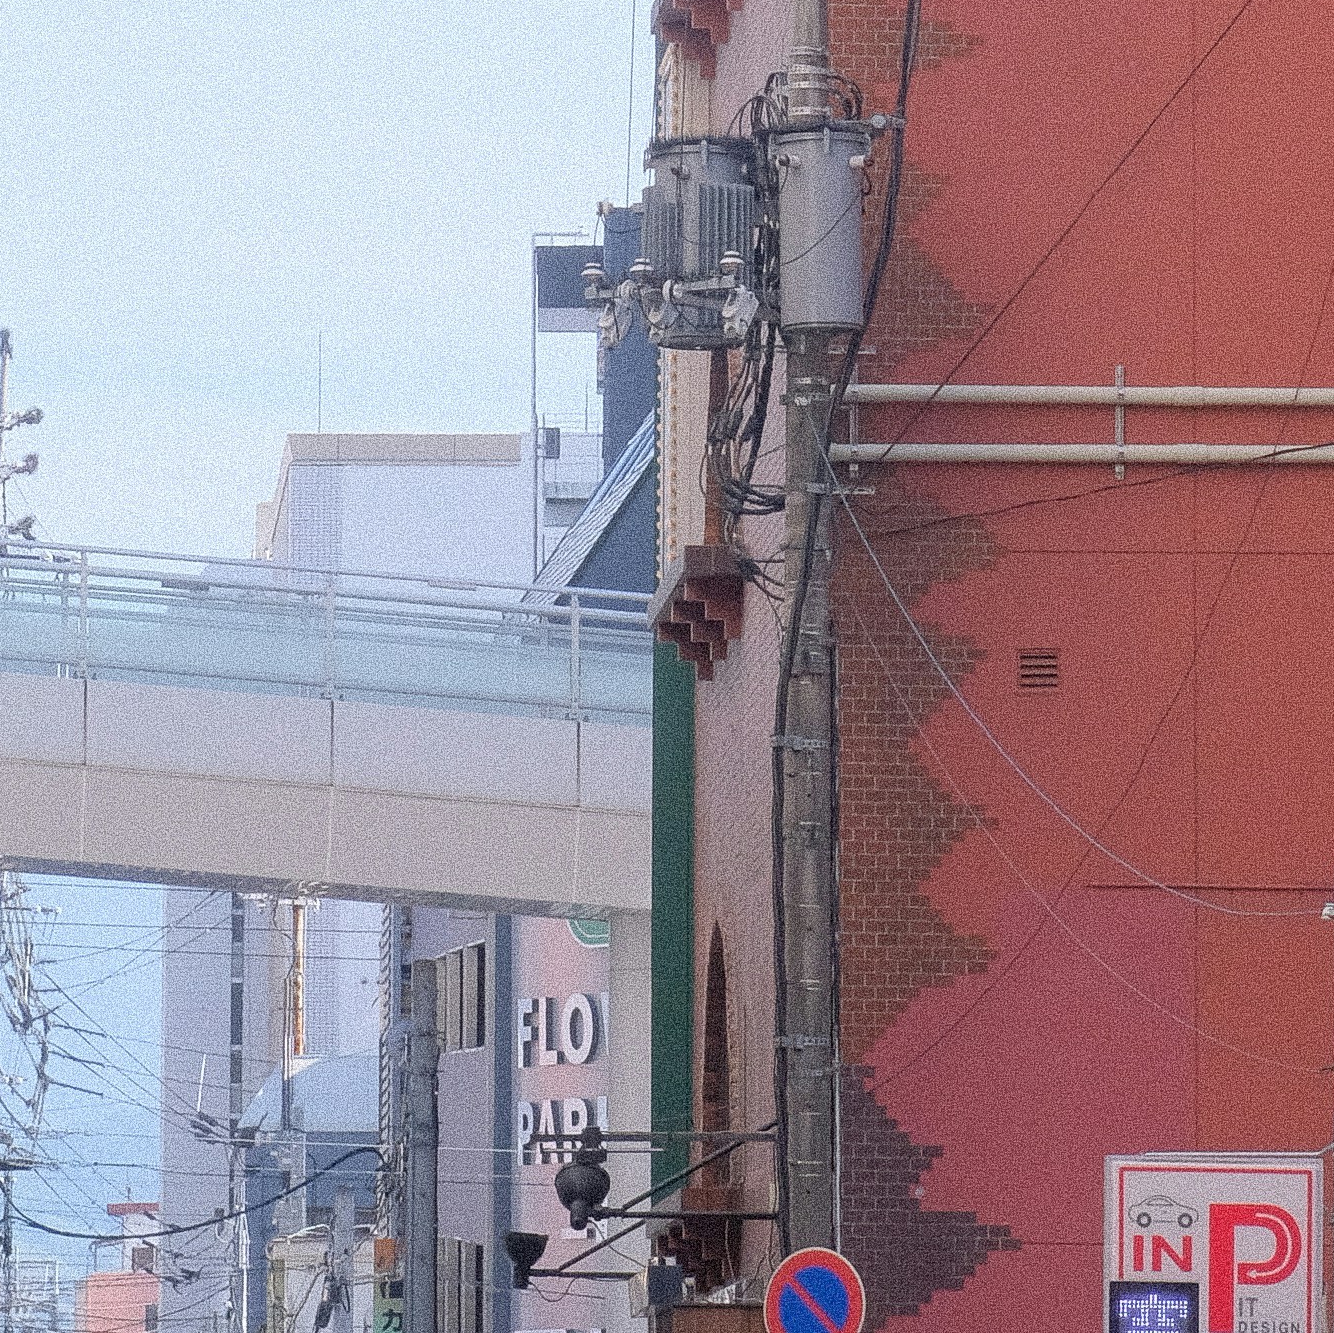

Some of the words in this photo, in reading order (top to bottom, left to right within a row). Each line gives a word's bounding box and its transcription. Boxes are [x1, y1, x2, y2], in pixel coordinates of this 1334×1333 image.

[518, 992, 609, 1068] FLO
[1133, 1235, 1193, 1272] IN
[1209, 1204, 1302, 1333] P
[1238, 1297, 1259, 1317] IT
[1238, 1322, 1301, 1333] DESIGN
